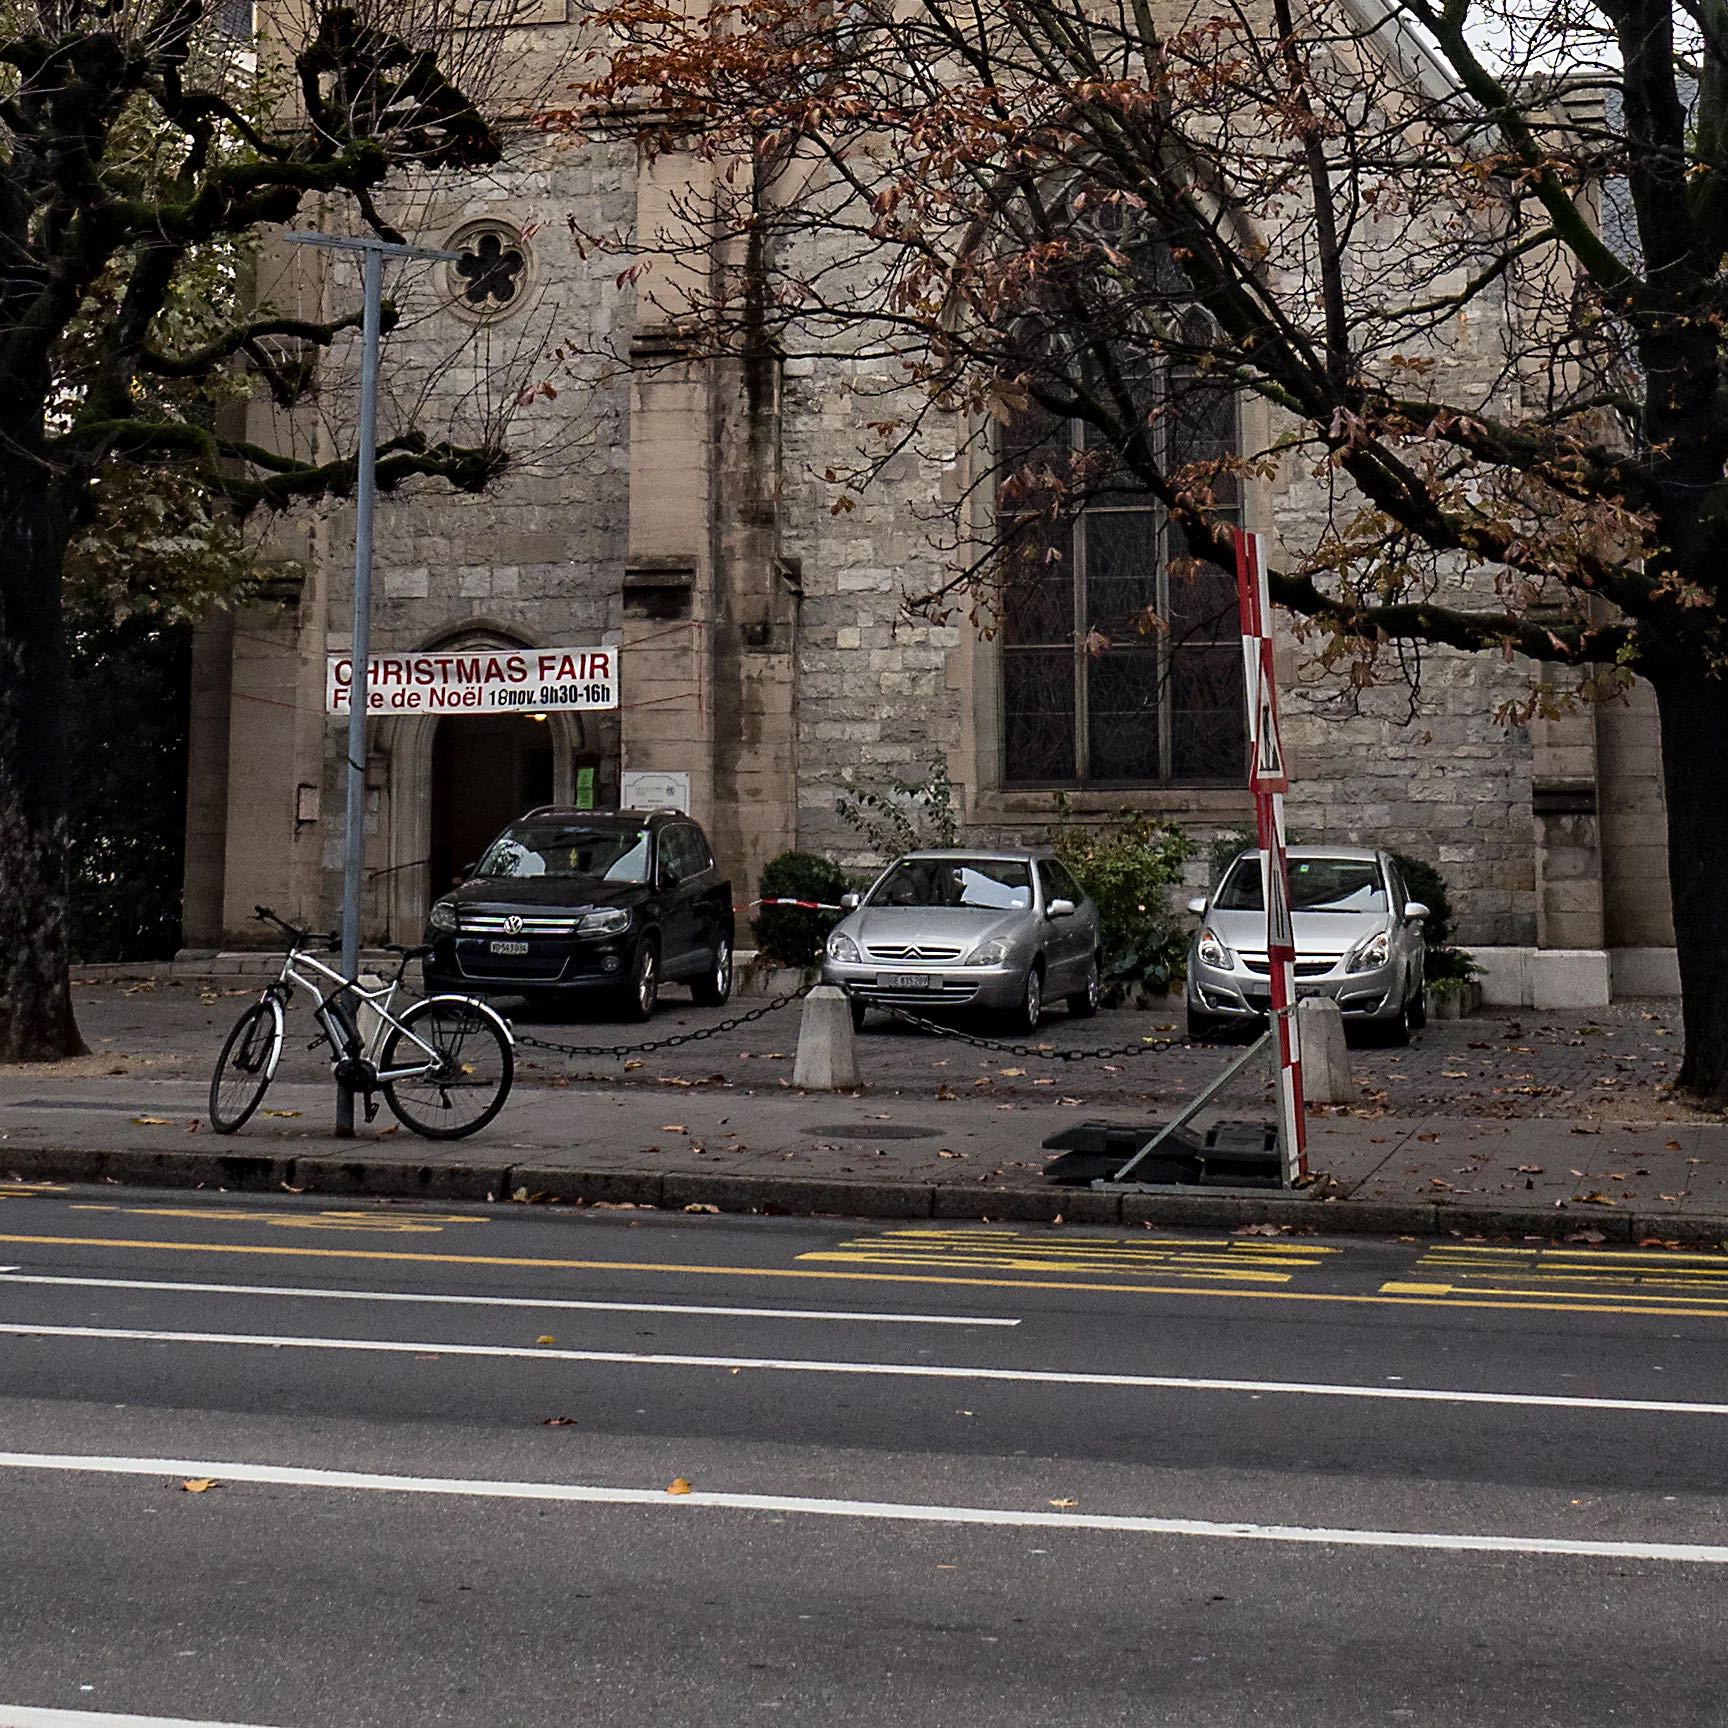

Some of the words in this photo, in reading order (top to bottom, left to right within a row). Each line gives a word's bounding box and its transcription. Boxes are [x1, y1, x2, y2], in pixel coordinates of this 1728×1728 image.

[335, 656, 528, 686] CHRISTMAS
[538, 653, 610, 681] FAIR
[333, 688, 384, 709] Fte
[391, 687, 421, 708] de
[429, 686, 483, 708] Noël
[540, 684, 611, 704] 9h30-16h
